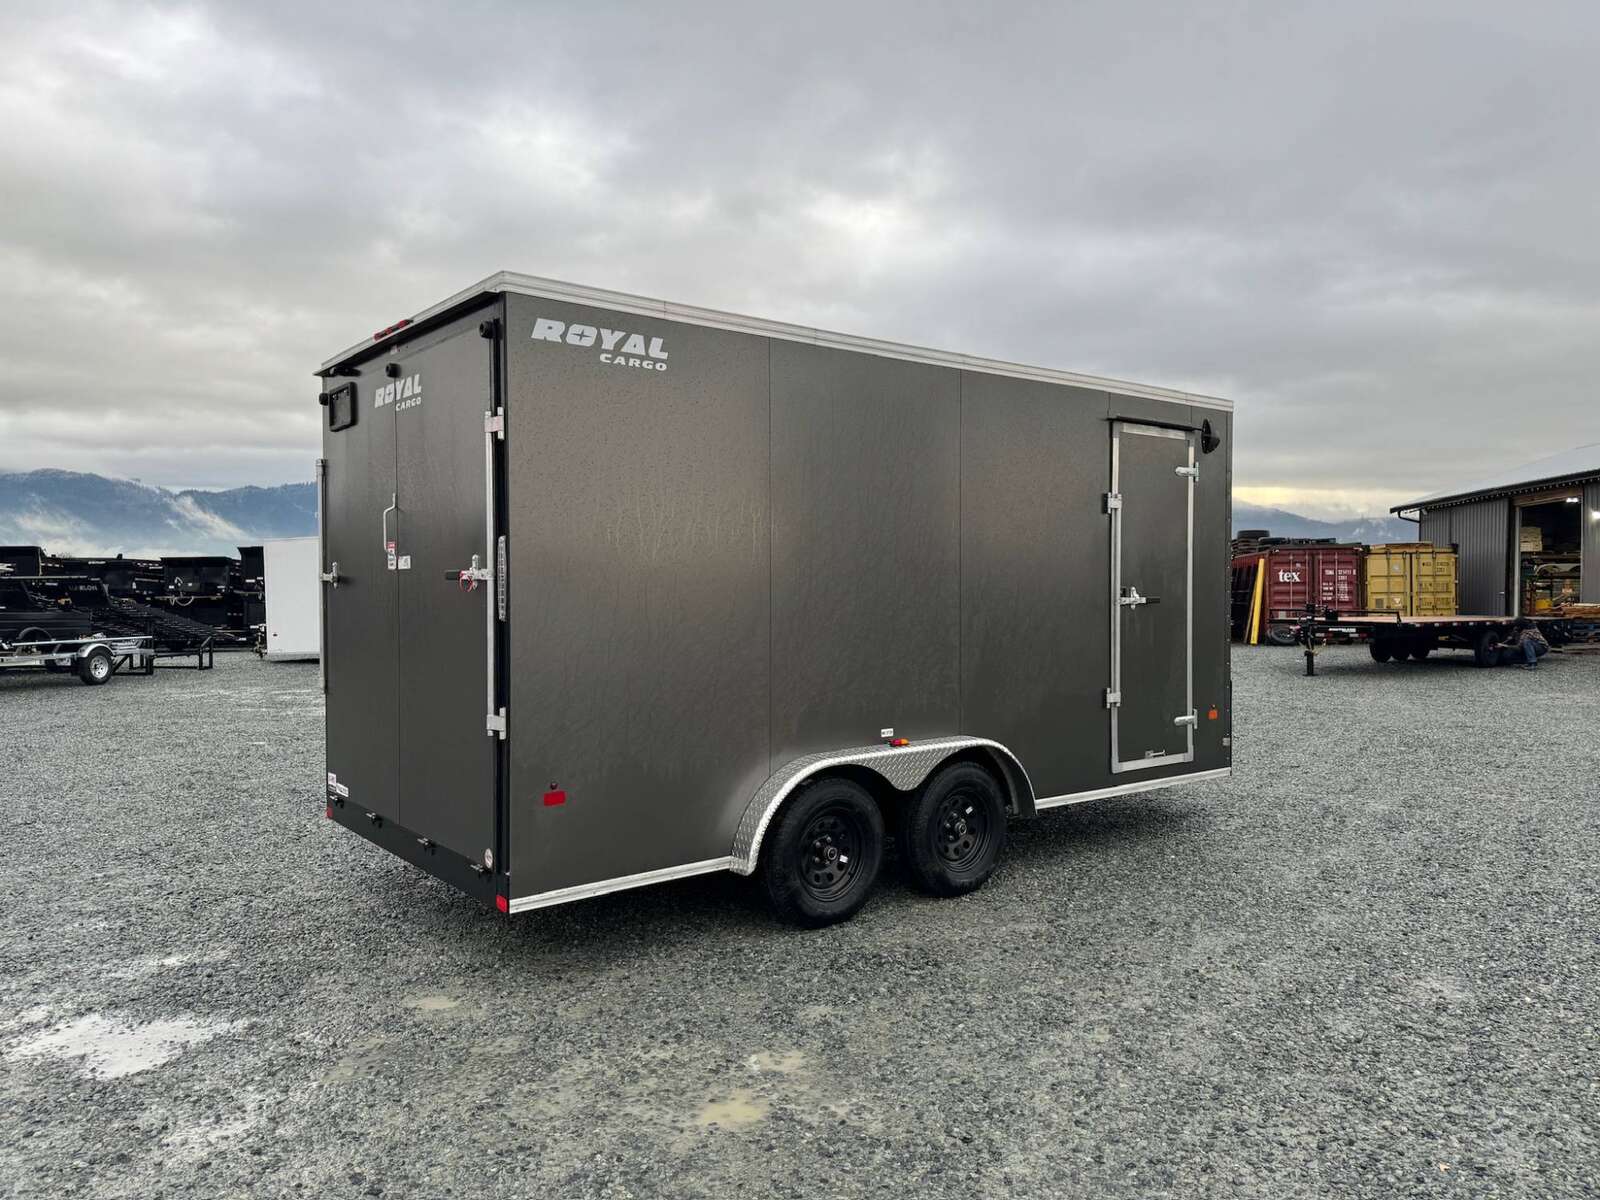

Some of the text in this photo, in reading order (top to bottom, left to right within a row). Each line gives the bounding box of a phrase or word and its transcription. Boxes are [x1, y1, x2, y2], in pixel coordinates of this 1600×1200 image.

[531, 318, 669, 360] ROYAL
[599, 353, 667, 371] CARGO
[374, 374, 422, 408] ROYAL
[396, 397, 421, 411] CARGO
[1278, 569, 1301, 582] tex
